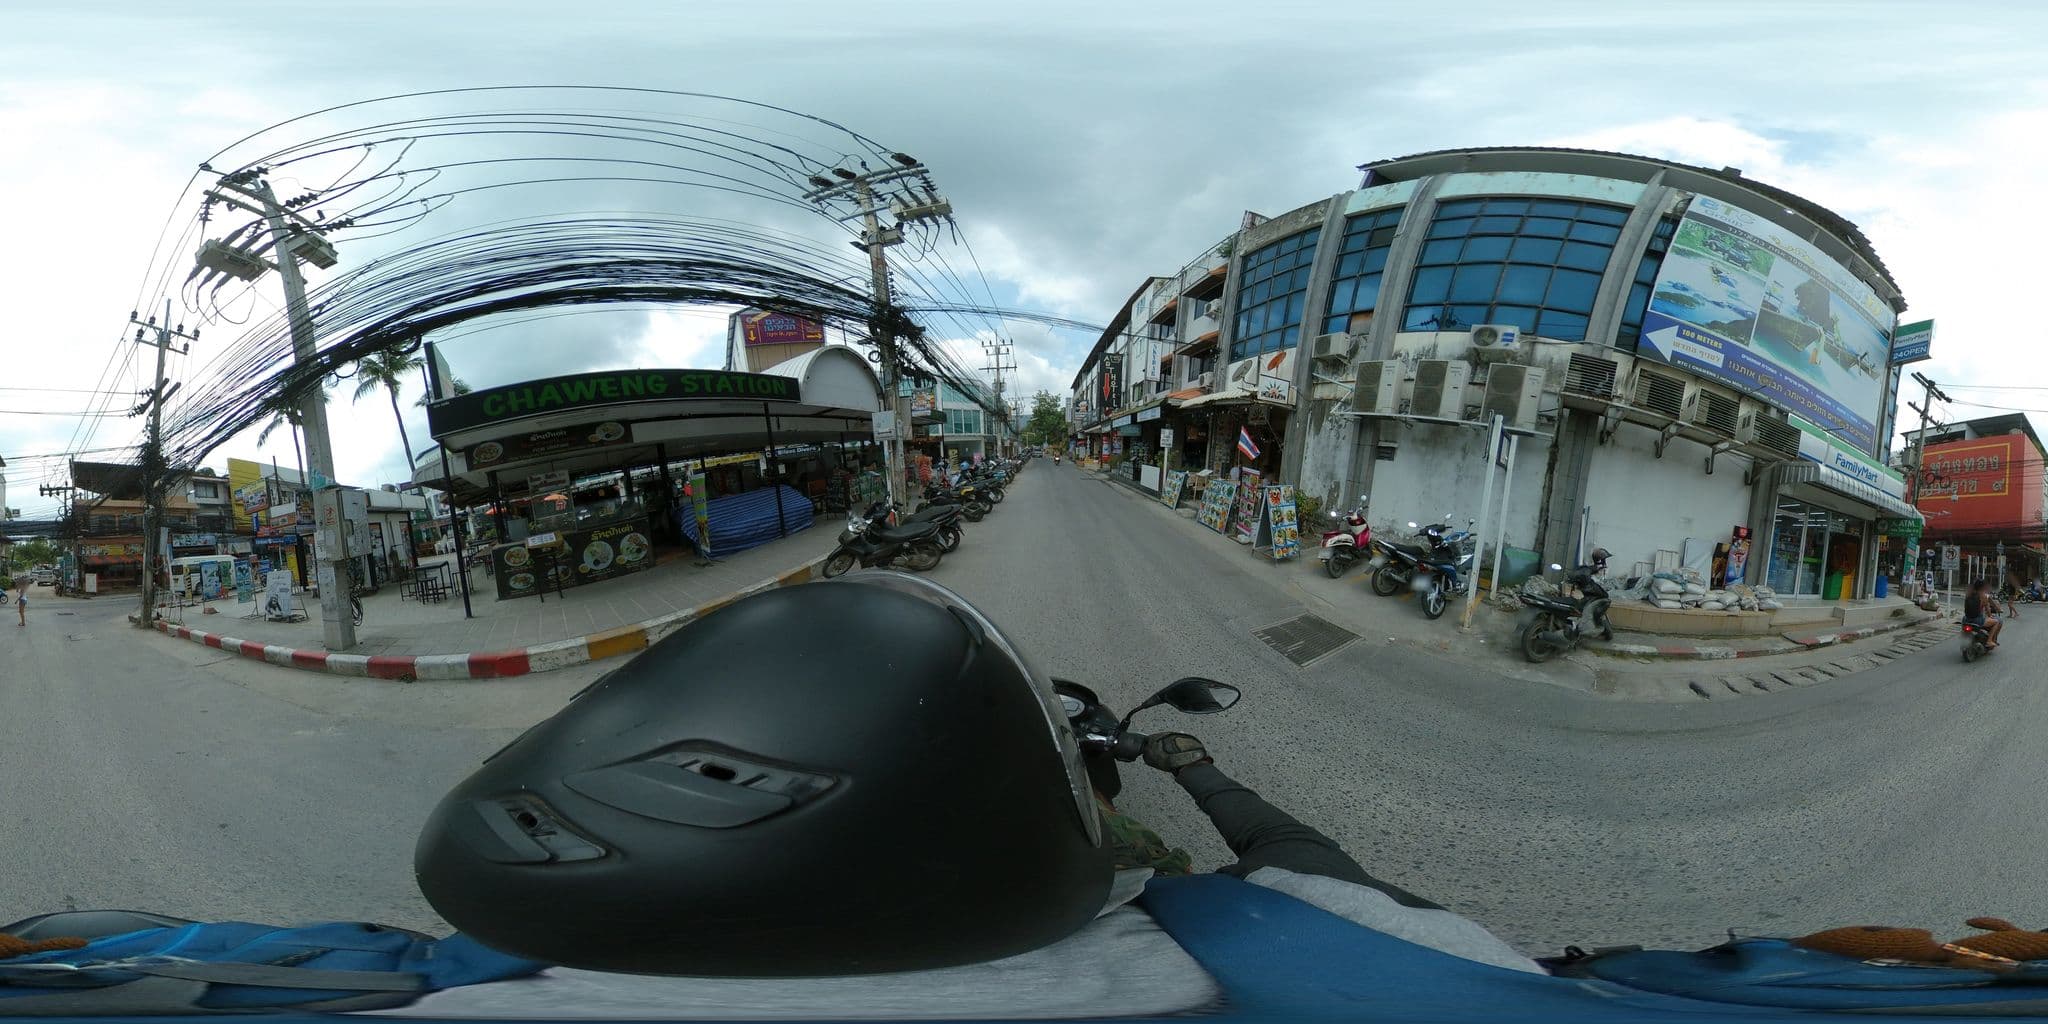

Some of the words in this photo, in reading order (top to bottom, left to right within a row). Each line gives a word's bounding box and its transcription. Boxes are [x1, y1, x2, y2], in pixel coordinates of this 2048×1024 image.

[1696, 335, 1723, 349] METERS
[483, 374, 669, 417] CHAWENG
[680, 374, 787, 395] STATION
[1835, 452, 1878, 483] FamilyMart
